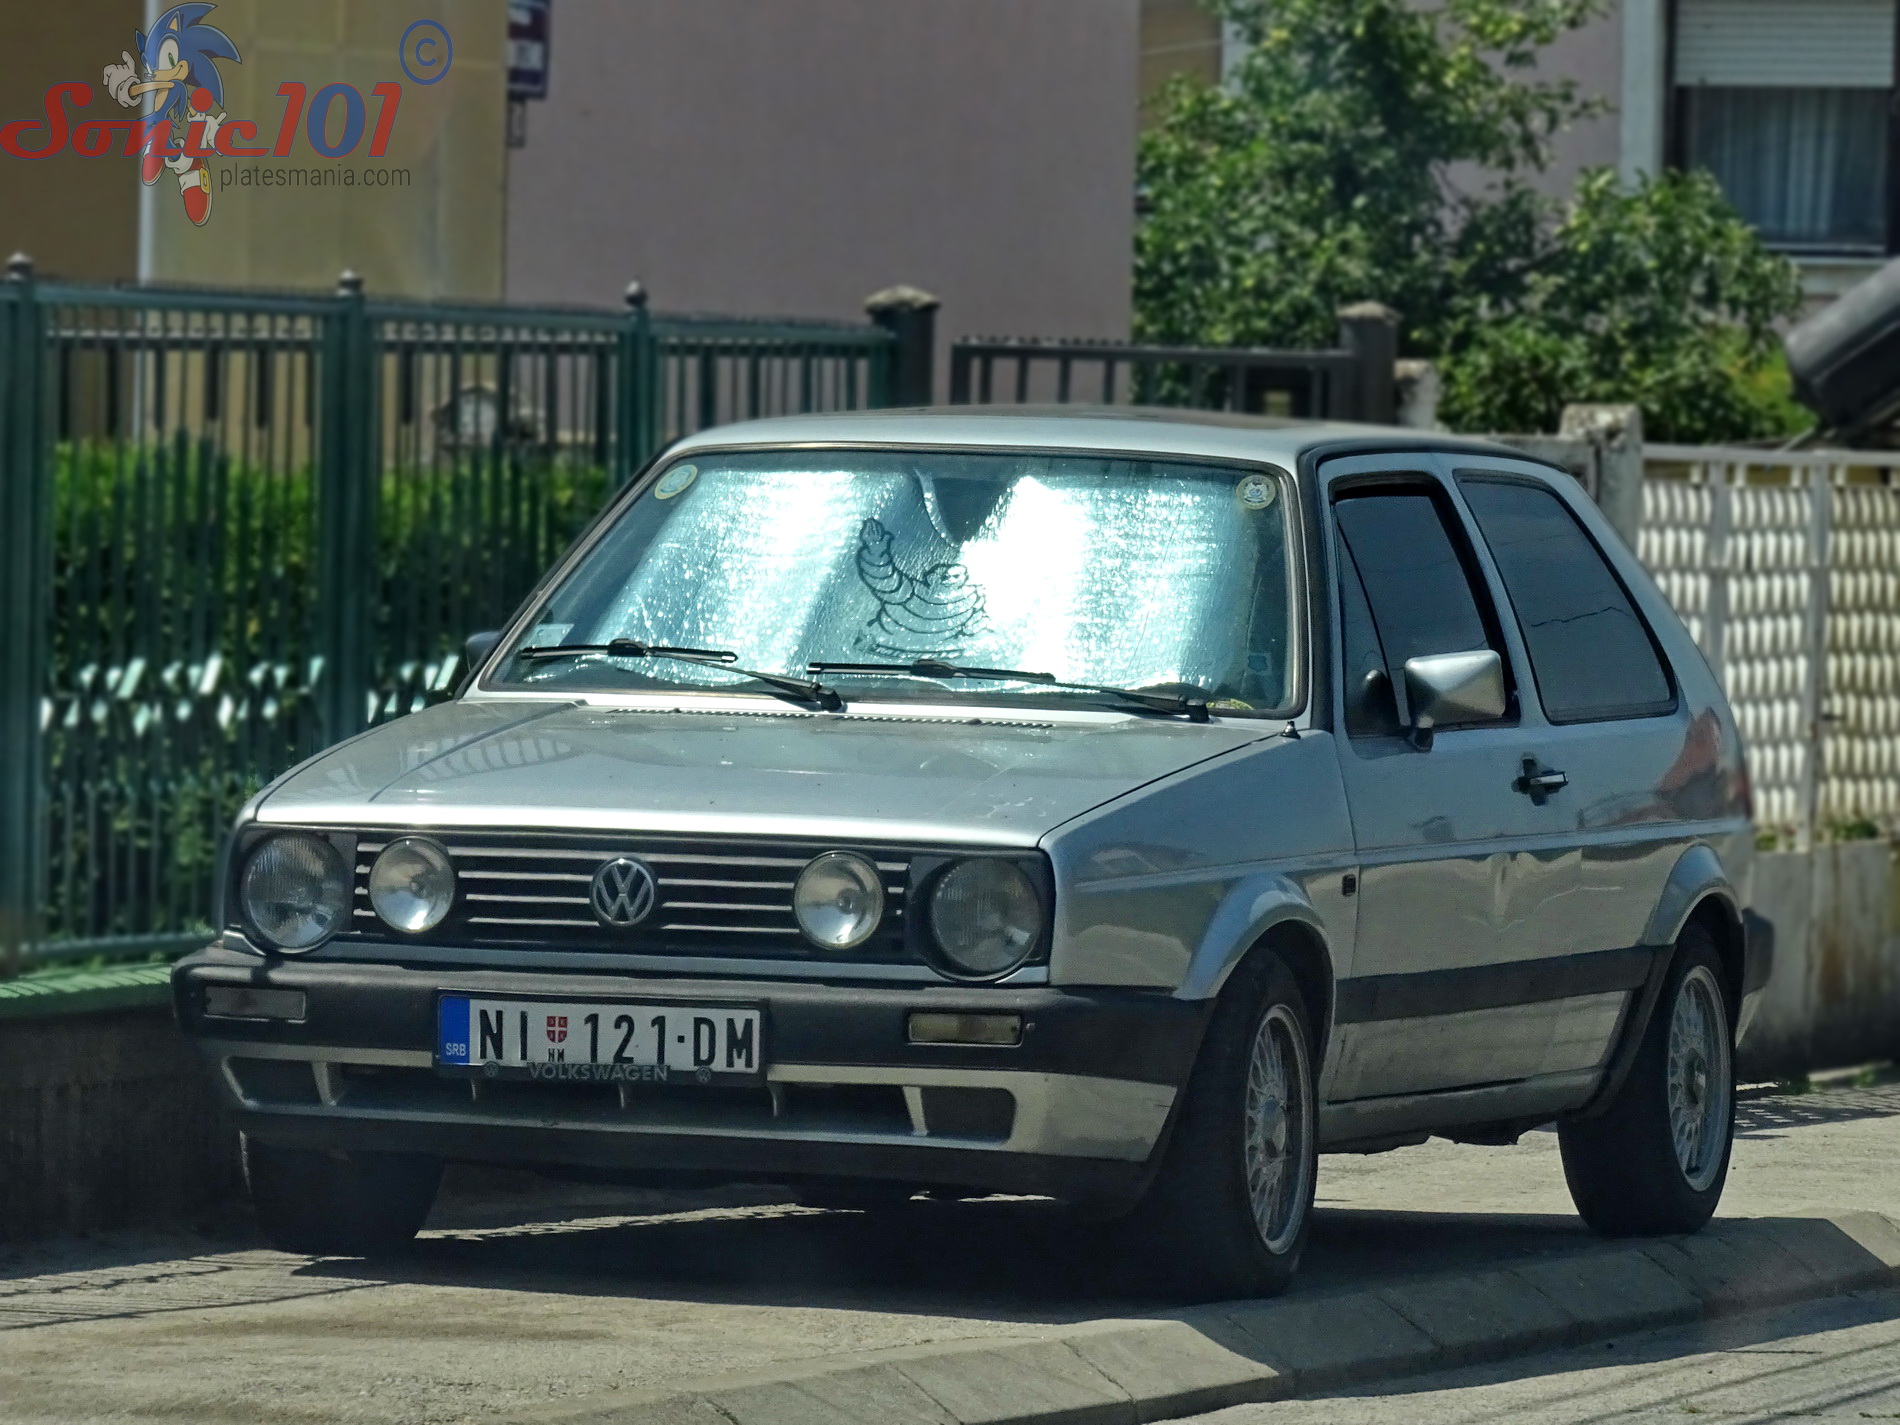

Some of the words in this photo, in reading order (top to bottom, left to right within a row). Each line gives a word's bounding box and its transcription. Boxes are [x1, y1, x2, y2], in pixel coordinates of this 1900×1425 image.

[479, 1009, 528, 1061] NI
[445, 1042, 467, 1056] SRB
[528, 1062, 668, 1081] VOLKSWAGEN
